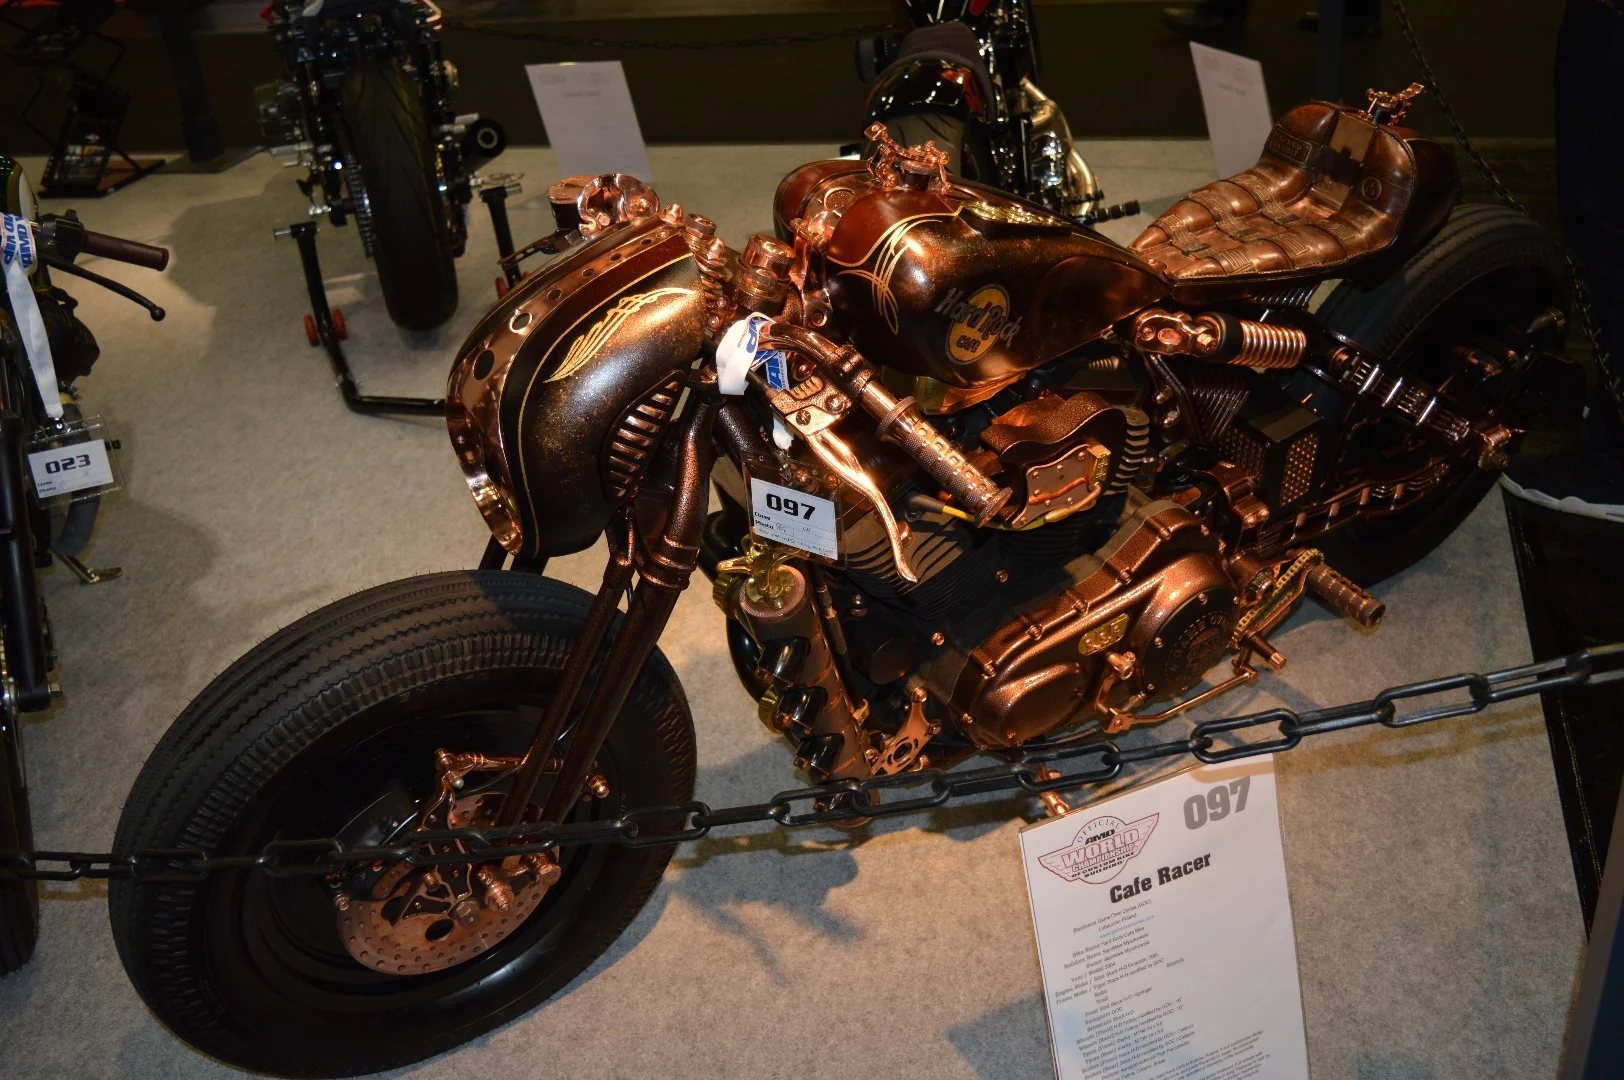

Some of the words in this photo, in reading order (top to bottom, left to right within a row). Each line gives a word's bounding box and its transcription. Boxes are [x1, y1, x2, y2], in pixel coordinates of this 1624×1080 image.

[934, 287, 993, 333] Hard
[981, 305, 1024, 348] Rock
[45, 454, 91, 474] 023
[754, 511, 771, 521] Class
[766, 493, 816, 521] 097
[755, 520, 774, 530] Photo
[1183, 776, 1251, 830] 097
[1076, 818, 1120, 843] OFFICIAL
[1084, 829, 1116, 845] AMD
[1061, 829, 1140, 869] WORLD
[1072, 842, 1136, 872] CHAMPIONSHIP
[1082, 859, 1116, 874] CUSTOM
[1116, 852, 1134, 861] BIKE
[1084, 860, 1122, 878] BUILDING
[1109, 876, 1152, 904] Cafe
[1157, 852, 1212, 886] Racer
